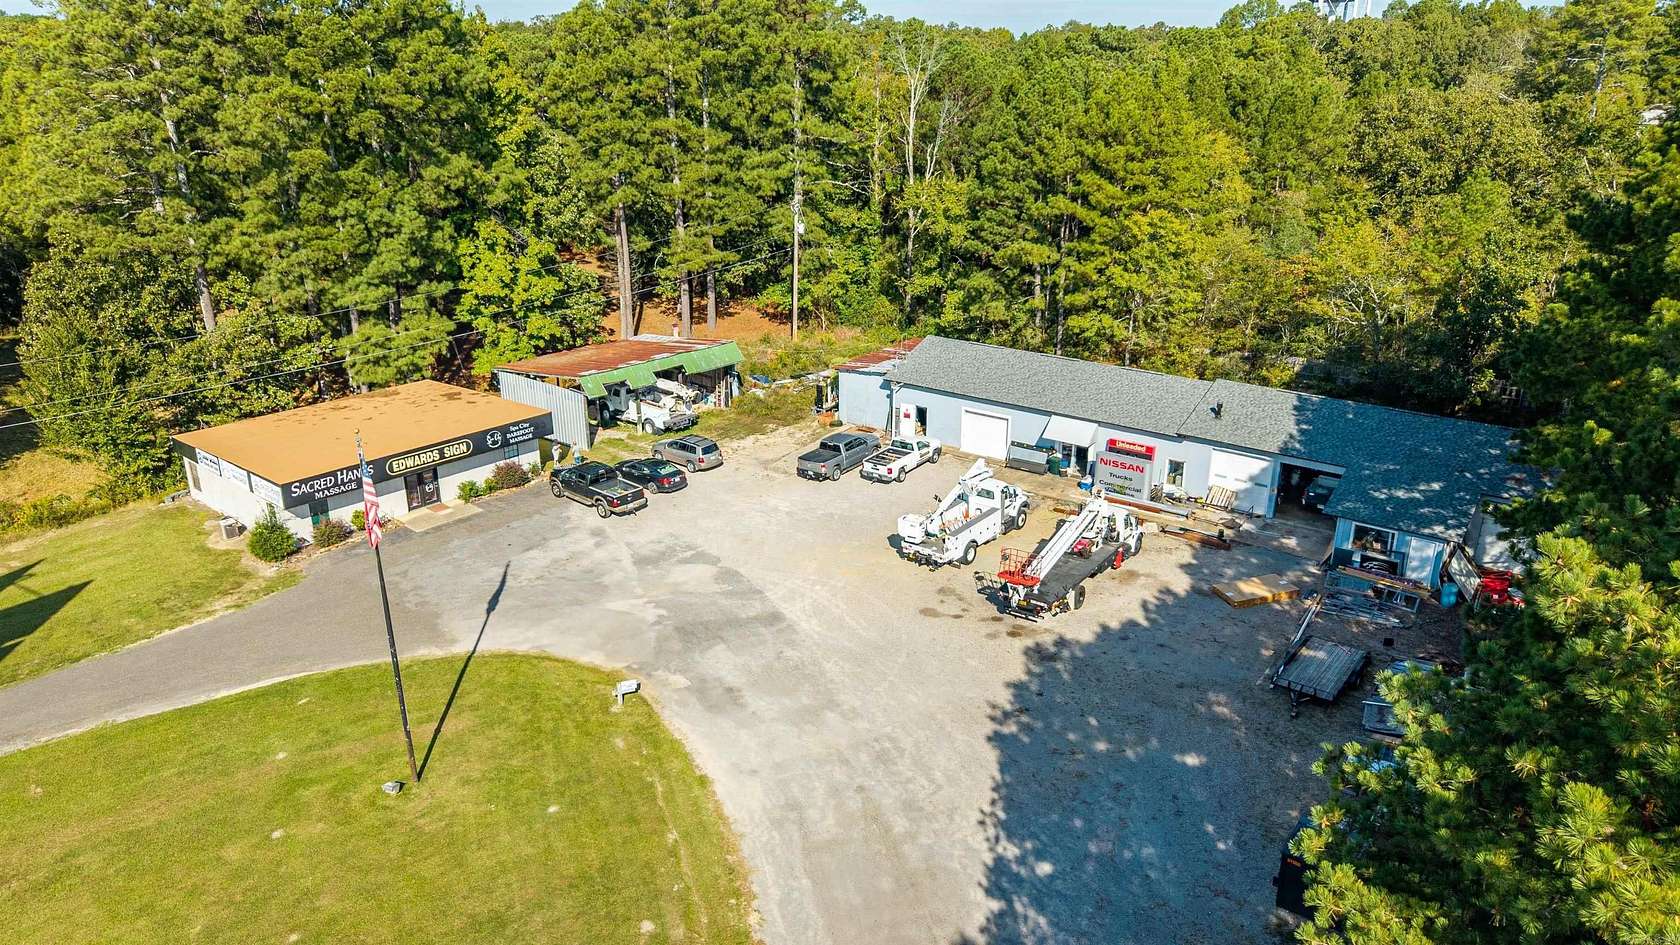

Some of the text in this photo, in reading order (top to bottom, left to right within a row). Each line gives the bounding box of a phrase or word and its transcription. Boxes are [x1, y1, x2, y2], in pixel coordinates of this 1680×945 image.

[392, 442, 467, 472] EDWARDS SIGN
[1099, 457, 1145, 474] NISSAN
[291, 476, 335, 497] SACRED
[336, 464, 374, 485] HANS
[1108, 472, 1133, 482] Trucks
[315, 481, 358, 500] MASSAGE
